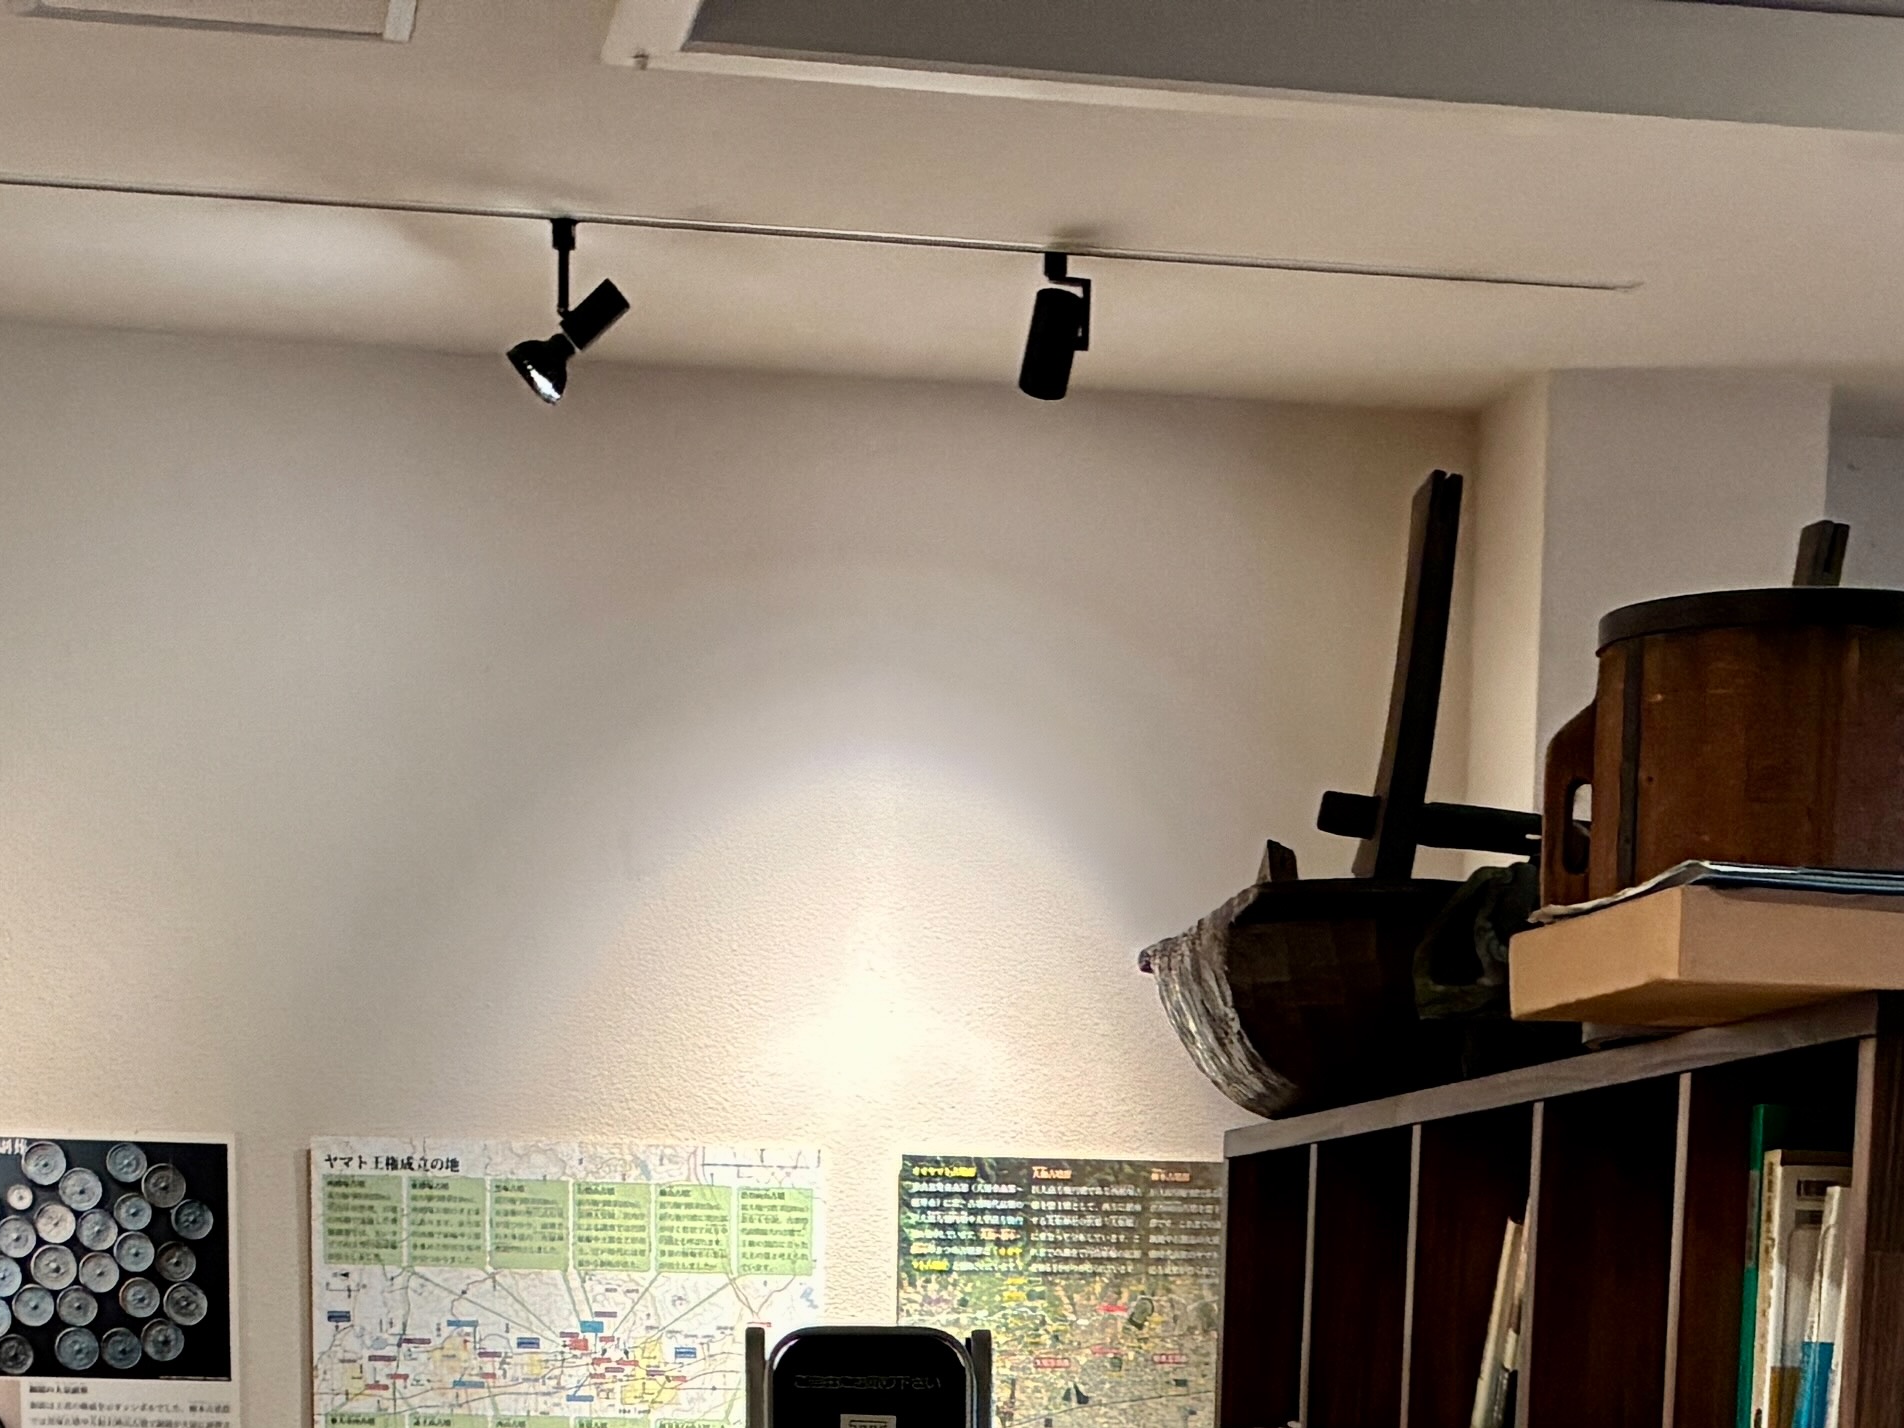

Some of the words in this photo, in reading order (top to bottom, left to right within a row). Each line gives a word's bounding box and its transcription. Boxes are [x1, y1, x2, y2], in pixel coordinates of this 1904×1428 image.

[324, 1154, 460, 1173] ヤマト王権成立の地
